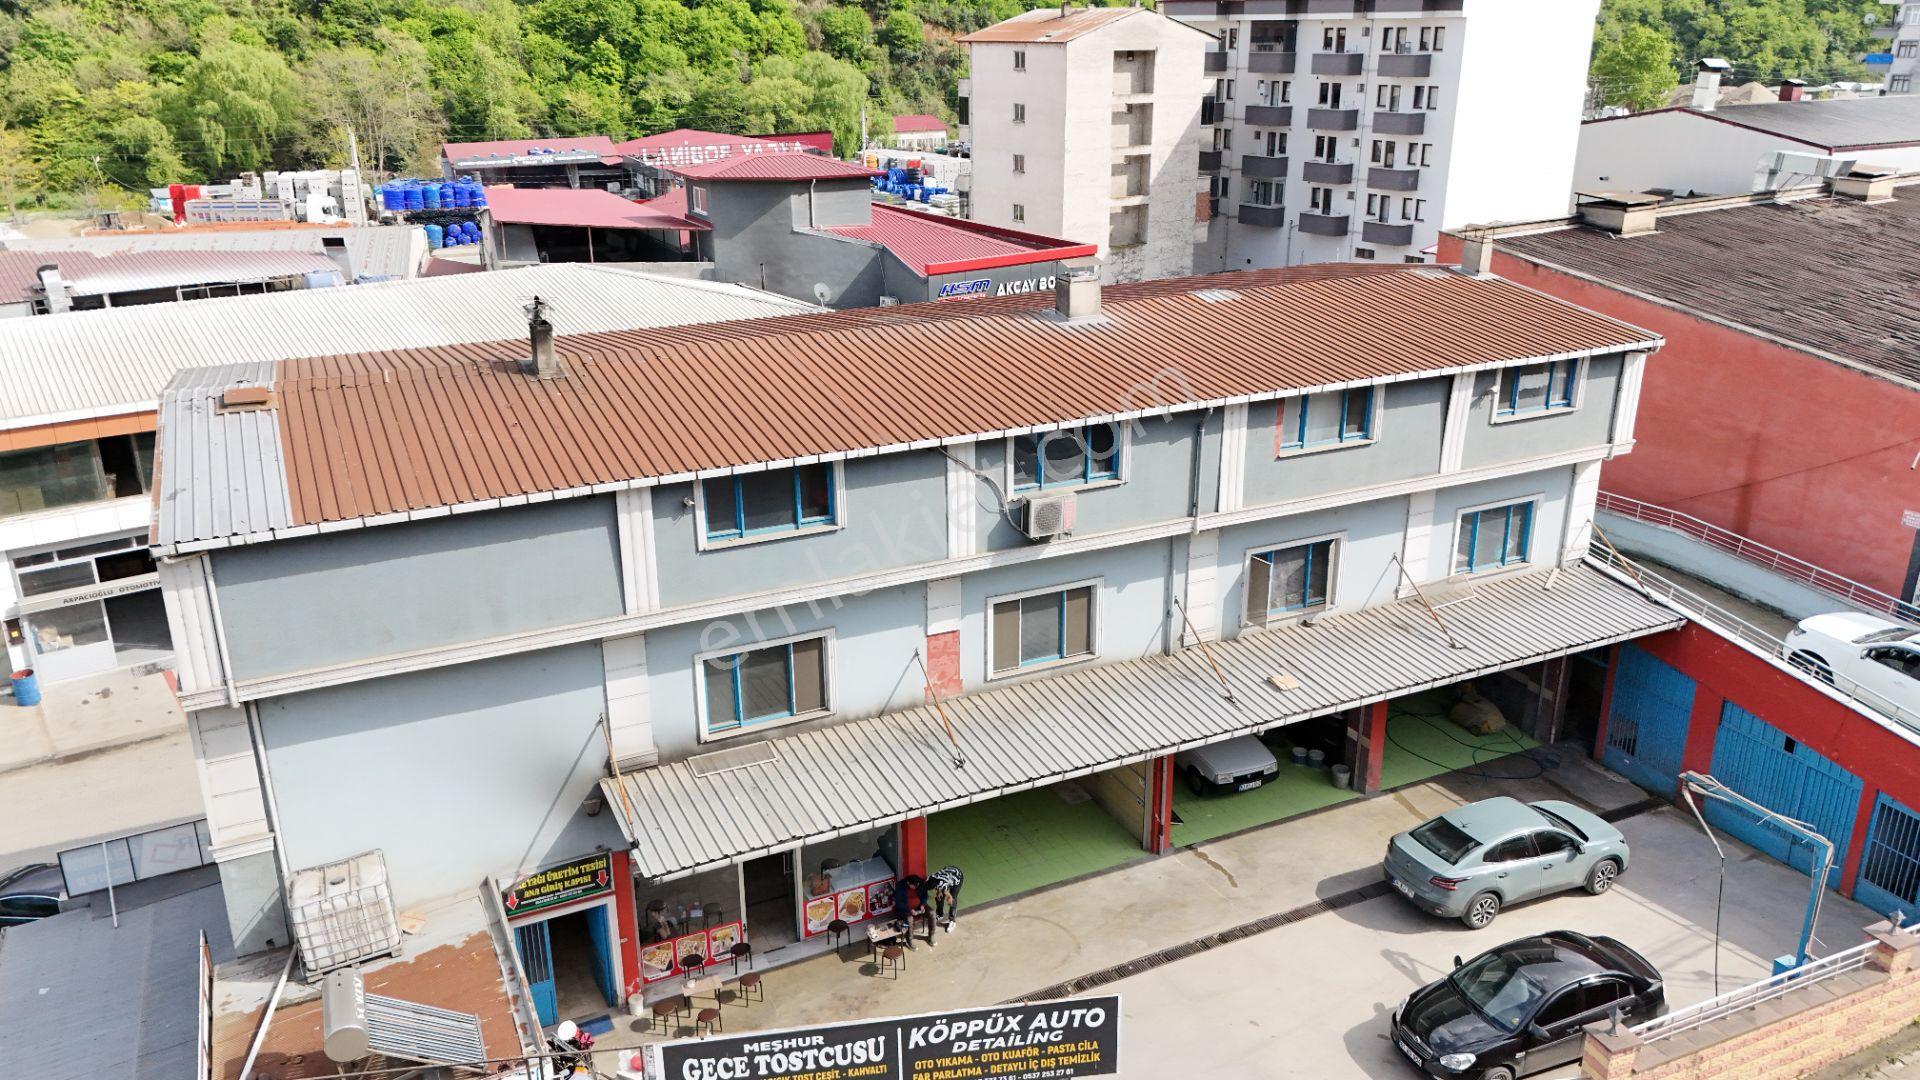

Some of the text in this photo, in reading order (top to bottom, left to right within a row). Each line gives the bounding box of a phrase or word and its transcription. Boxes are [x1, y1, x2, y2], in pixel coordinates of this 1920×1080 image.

[939, 279, 991, 296] HSM
[547, 866, 580, 882] ÜRETİM
[580, 857, 607, 873] TESİSİ
[908, 1008, 1105, 1049] KÖPPÜX AUTO
[743, 1035, 825, 1053] MEŞHUR
[915, 1059, 934, 1070] OTO
[936, 1055, 973, 1068] YIKAMA
[981, 1052, 999, 1062] OTO
[1002, 1046, 1040, 1060] KUAFÖR
[1047, 1043, 1076, 1055] PASTA
[1078, 1040, 1099, 1051] CİLA
[682, 1036, 886, 1080] GECE TOSTCUSU
[848, 1064, 887, 1077] KAHVALTI
[933, 1066, 982, 1080] PARLATMA
[990, 1061, 1027, 1074] DETAYLI
[1041, 1057, 1056, 1069] DIŞ
[1058, 1051, 1101, 1066] TEMİZLİK
